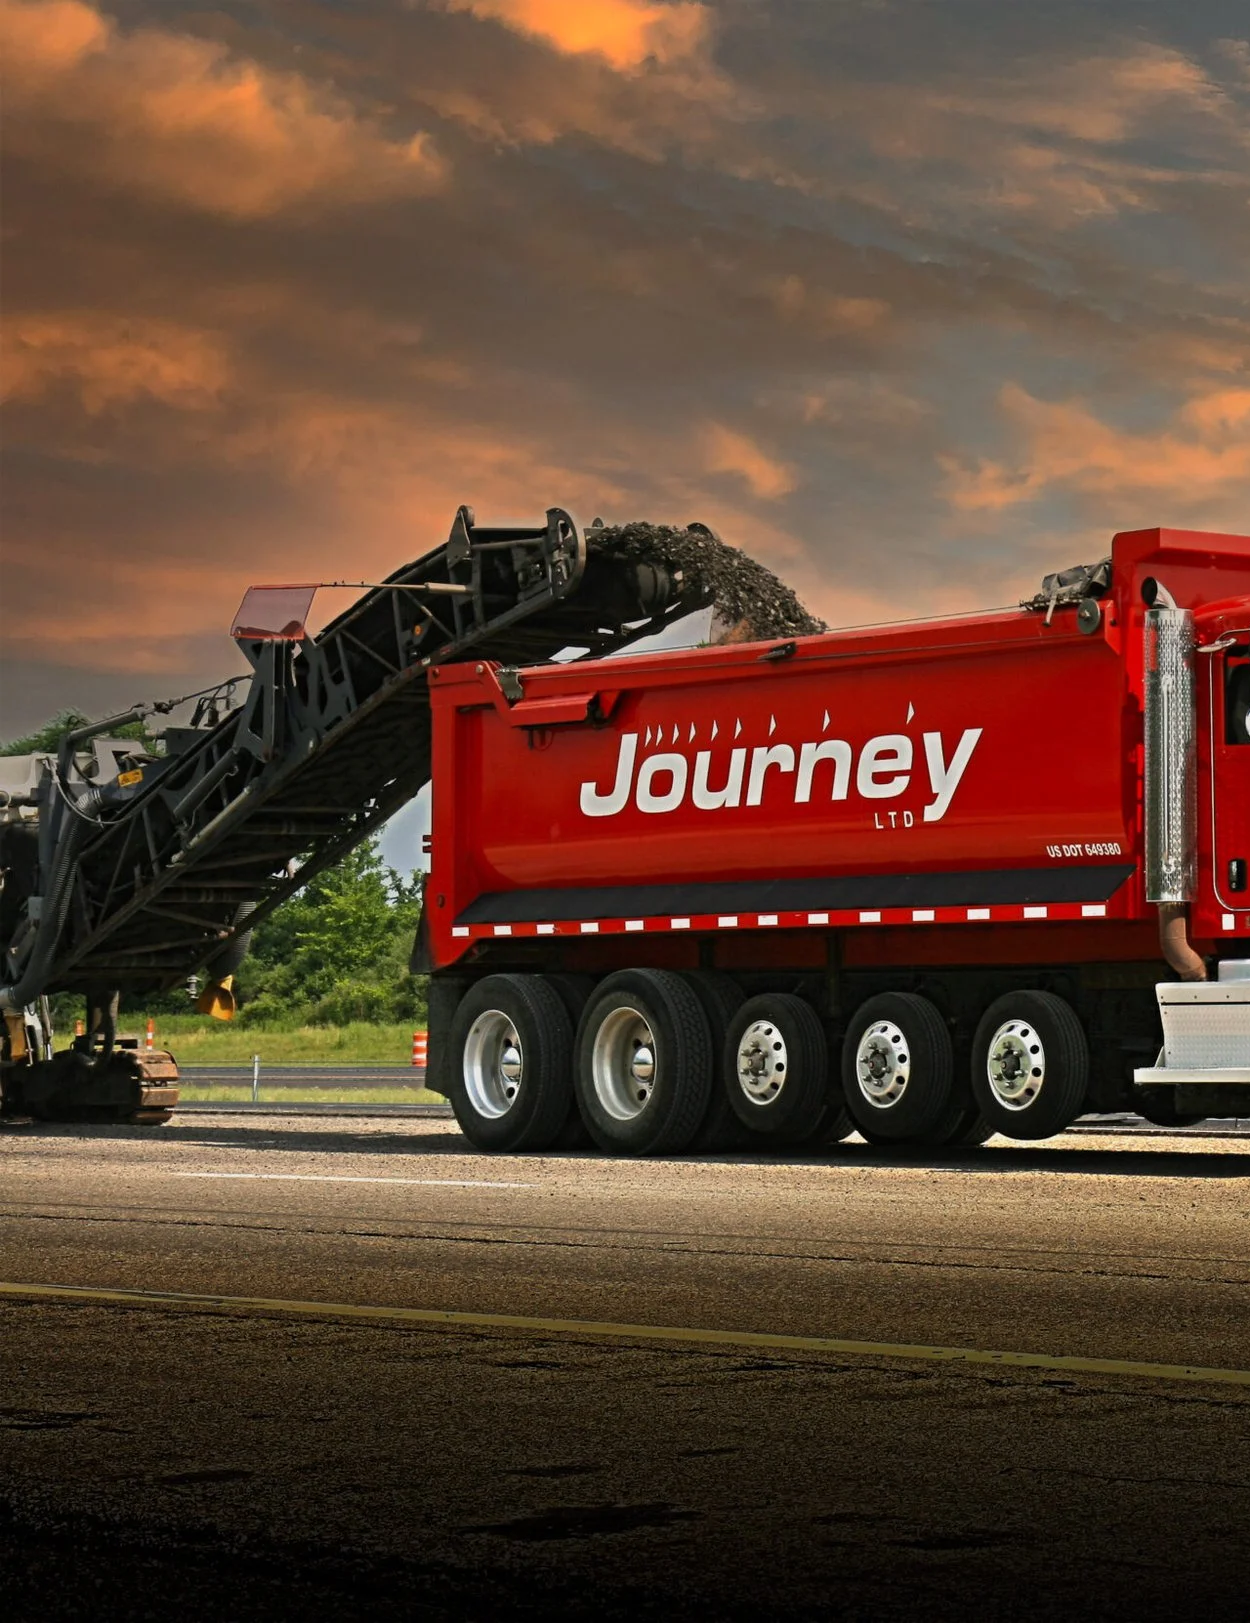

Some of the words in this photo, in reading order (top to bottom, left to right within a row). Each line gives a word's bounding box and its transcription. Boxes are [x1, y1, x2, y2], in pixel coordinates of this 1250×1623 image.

[579, 727, 983, 822] Journey
[874, 810, 914, 829] LTD
[1046, 845, 1062, 858] US
[1062, 844, 1083, 857] DOT
[1084, 842, 1122, 856] 649380
